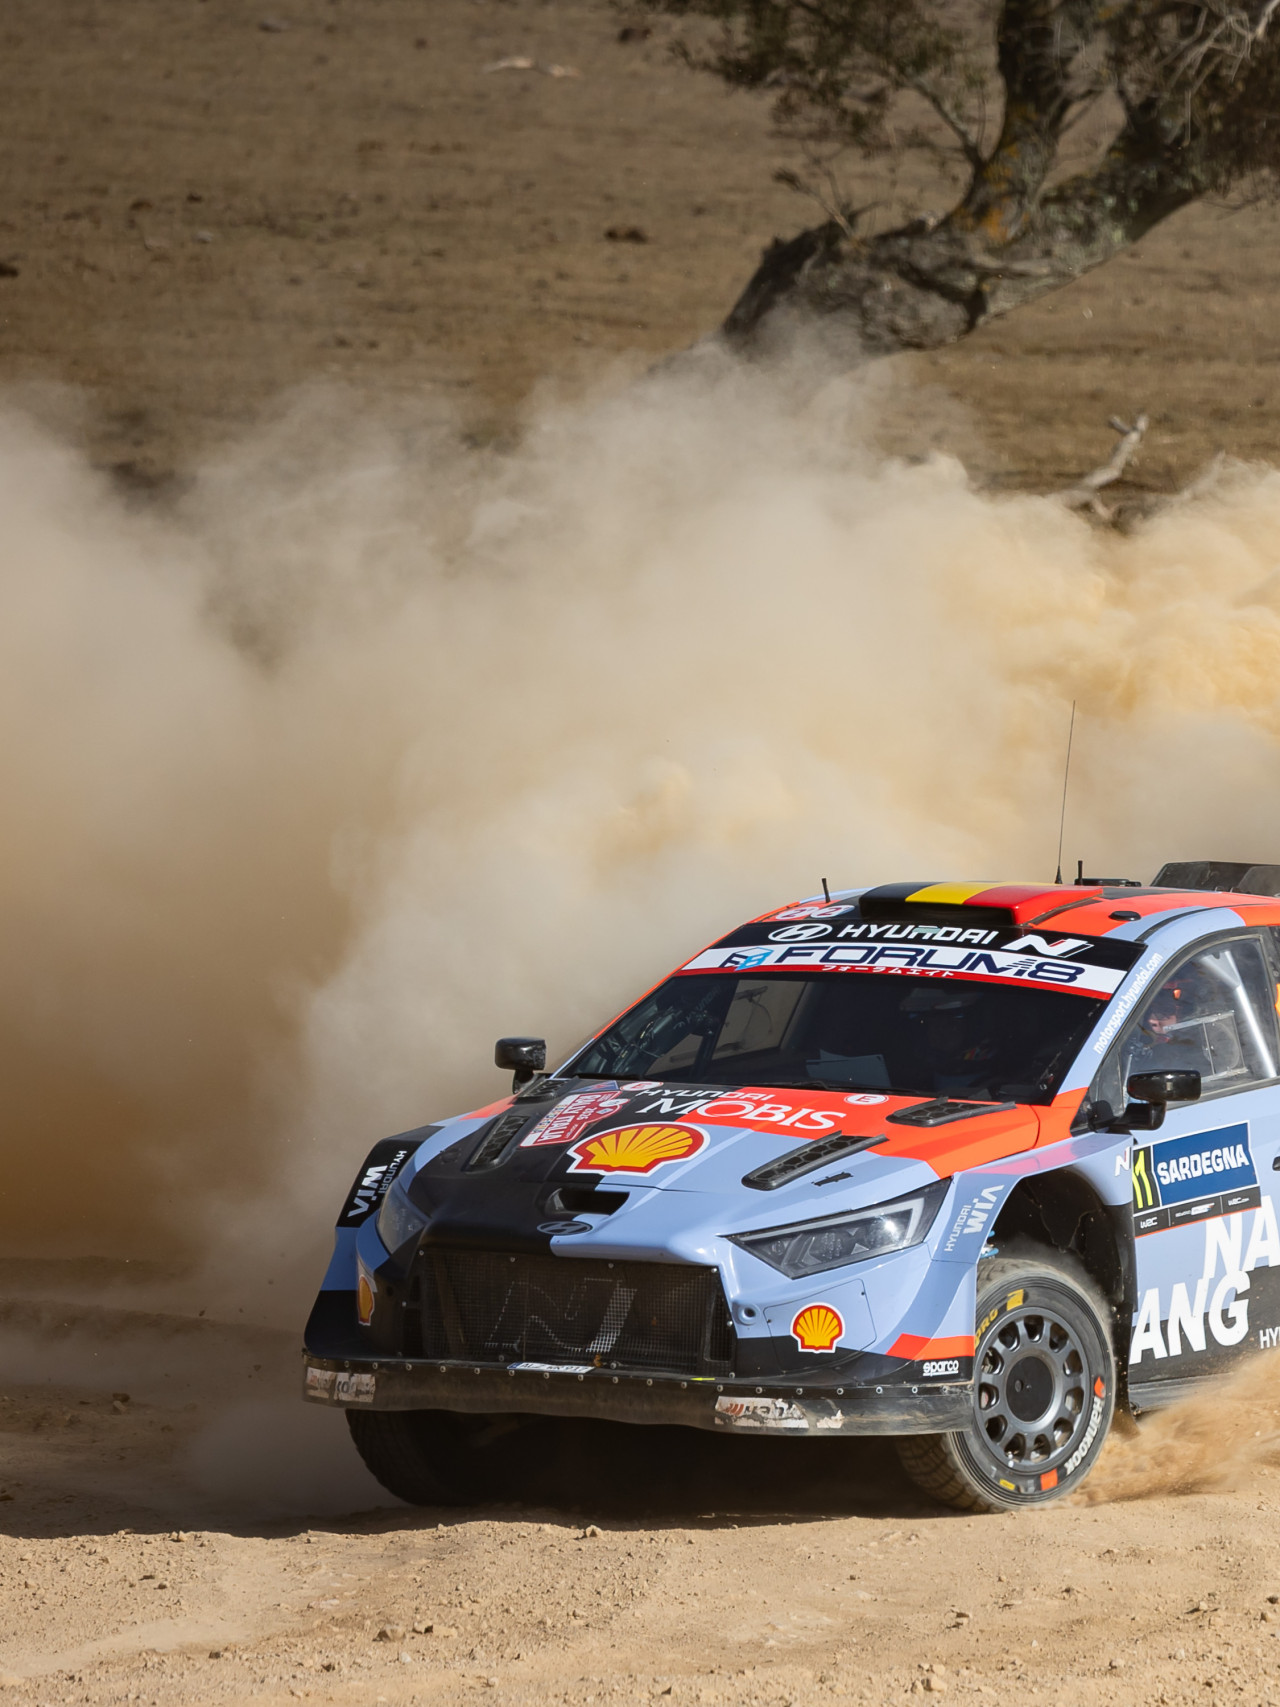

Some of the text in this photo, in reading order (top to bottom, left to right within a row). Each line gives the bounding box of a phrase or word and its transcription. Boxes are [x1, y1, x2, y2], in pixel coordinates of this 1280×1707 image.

[836, 923, 999, 945] HYUNDAI
[775, 945, 1086, 984] FORUM8
[822, 963, 955, 978] フォーラムエイト
[1093, 952, 1164, 1055] motorsport.hyundai.com
[635, 1089, 776, 1101] HYUNDAI
[635, 1097, 847, 1130] MOBIS
[377, 1150, 408, 1194] HYUNDAI
[1156, 1143, 1250, 1186] SARDEGNA
[943, 1204, 972, 1252] HYUNDAI
[1128, 1270, 1251, 1365] ANG
[922, 1359, 960, 1377] sparco
